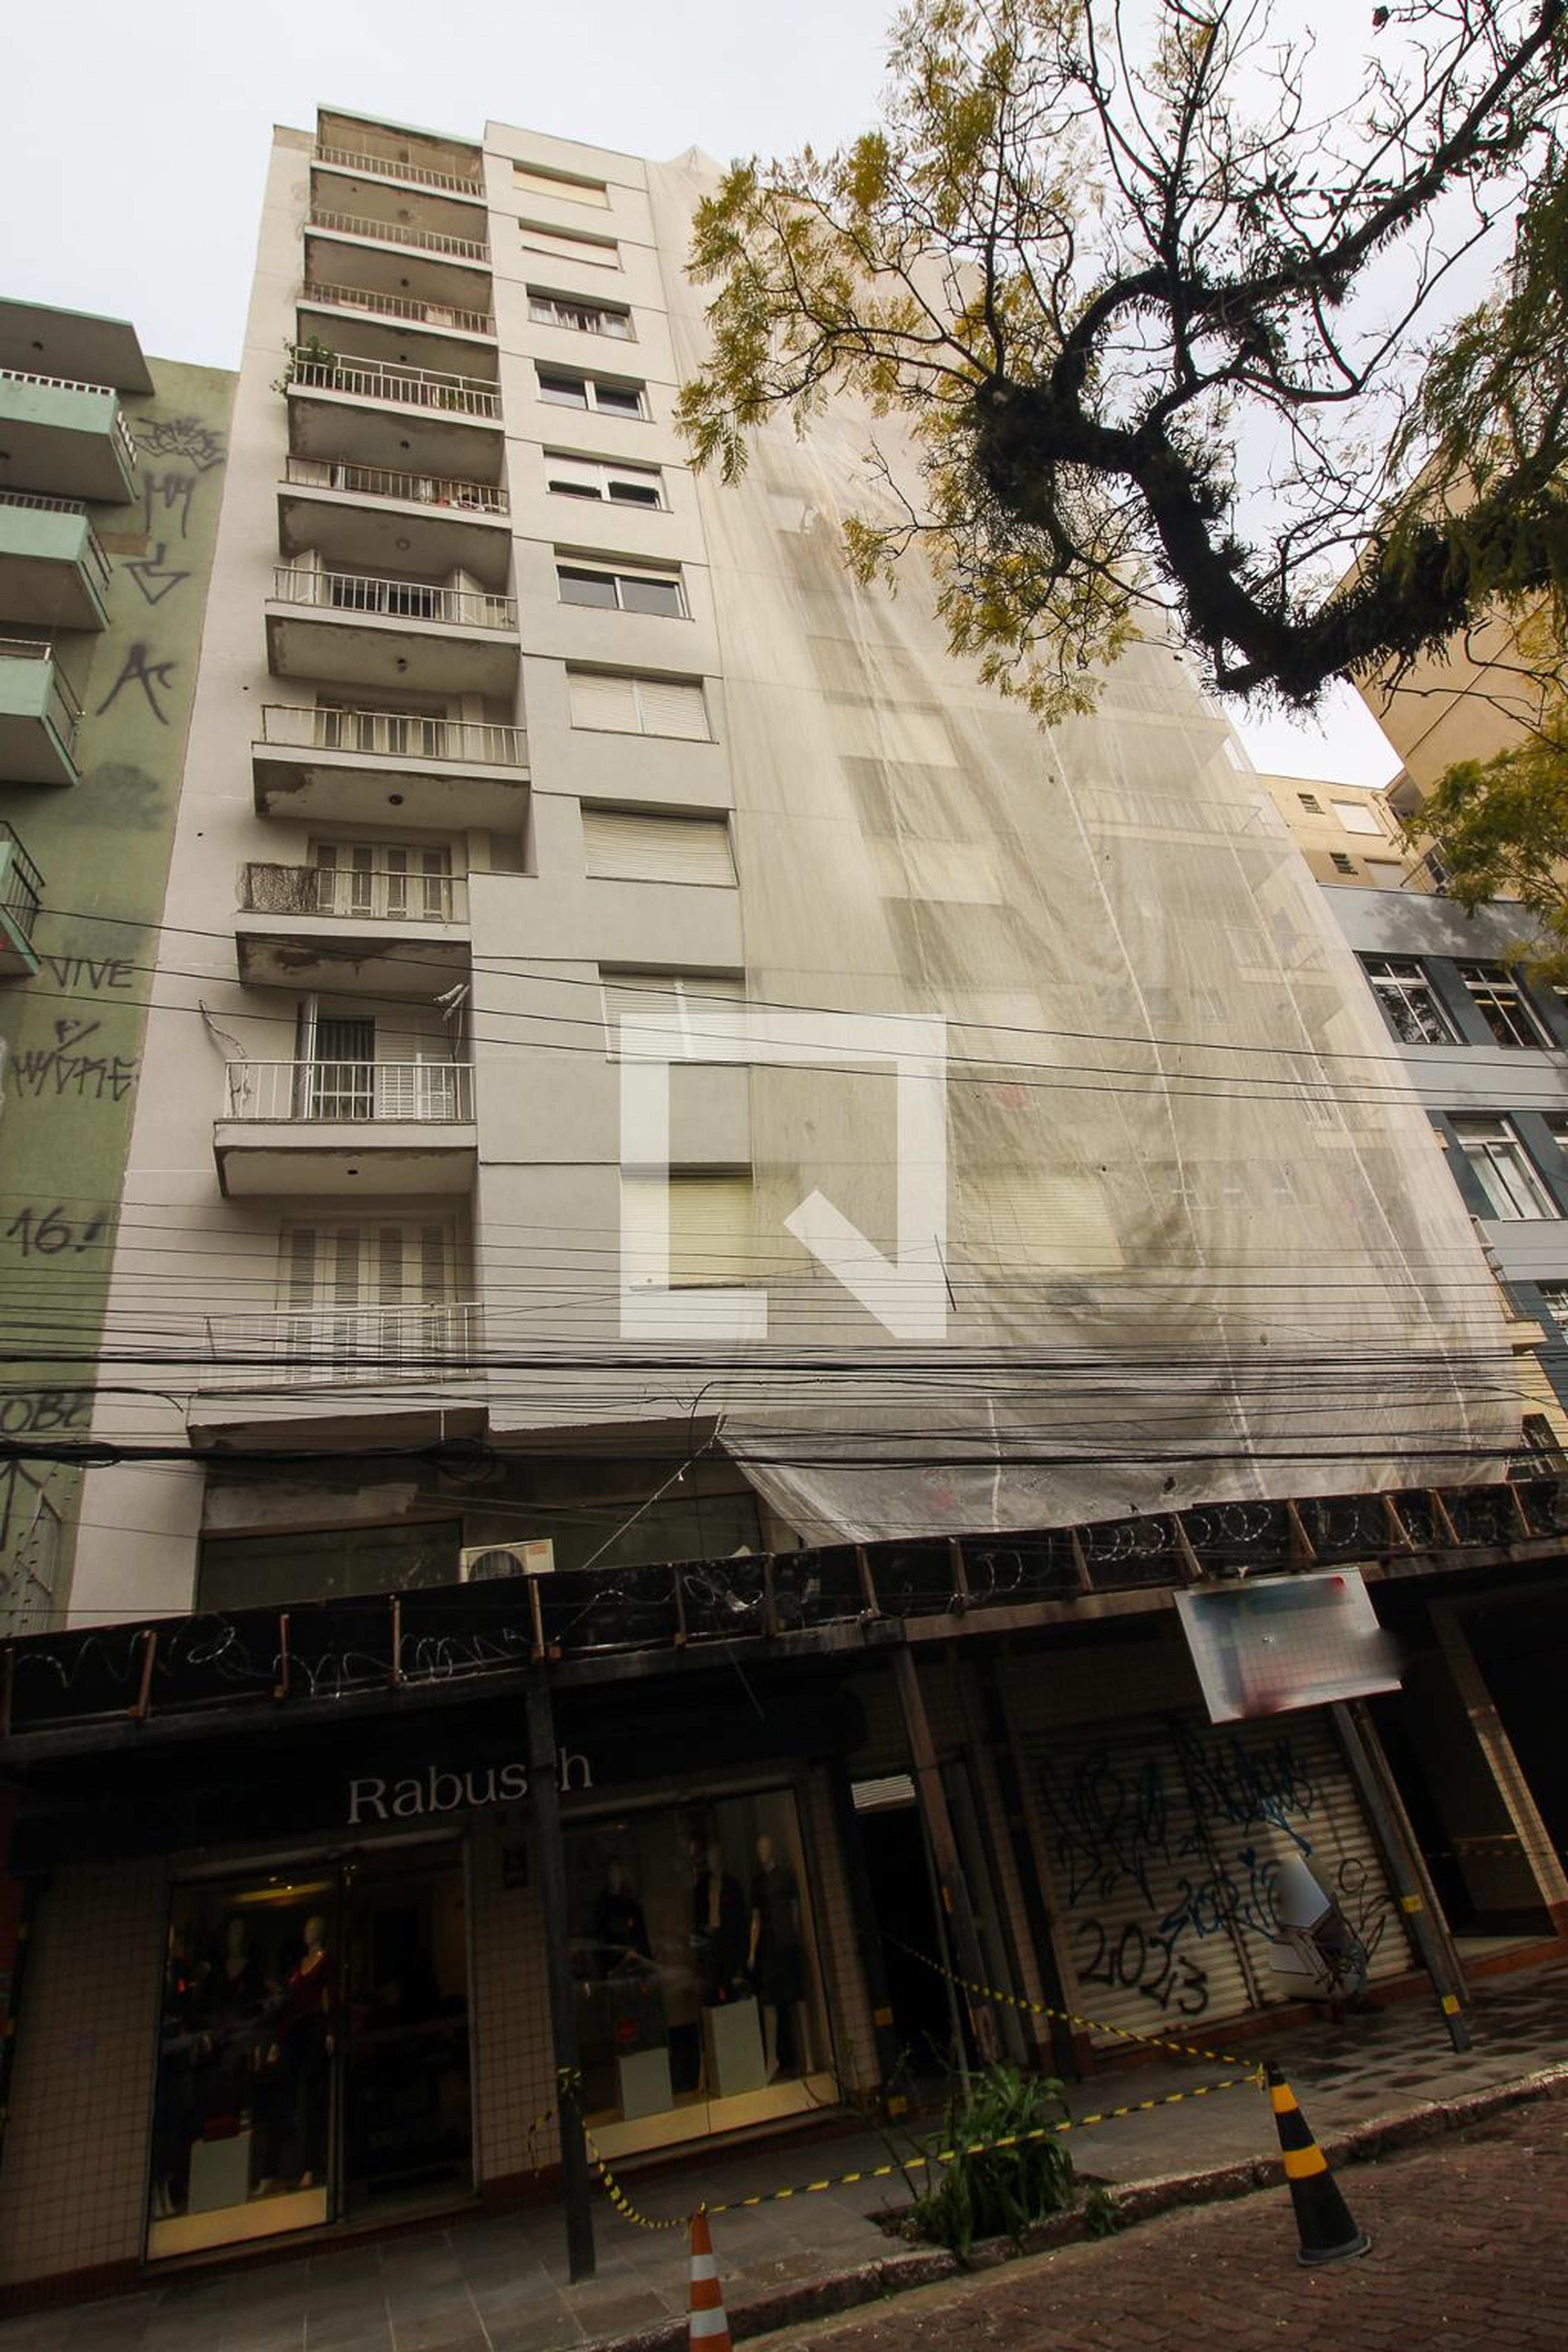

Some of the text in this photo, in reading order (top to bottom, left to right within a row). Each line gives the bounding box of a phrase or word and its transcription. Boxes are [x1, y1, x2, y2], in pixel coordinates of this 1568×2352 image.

[48, 957, 135, 989] VIVE
[347, 1747, 593, 1824] Rabush
[1077, 1920, 1209, 2014] 2023
